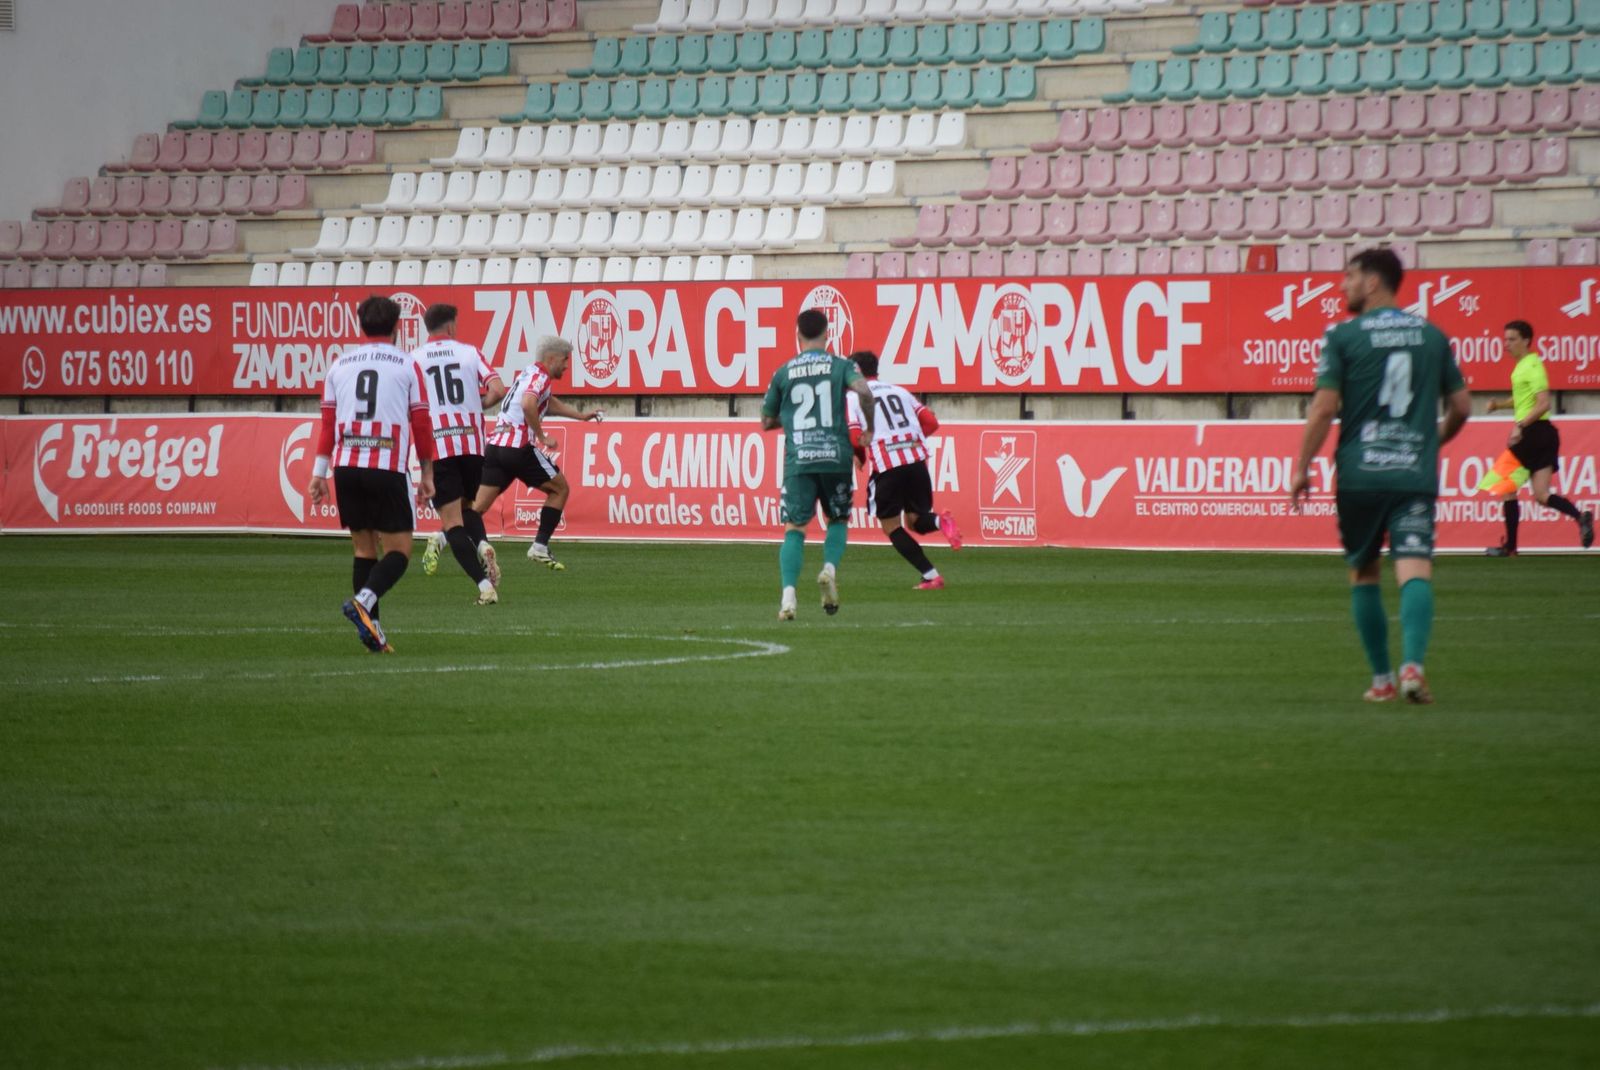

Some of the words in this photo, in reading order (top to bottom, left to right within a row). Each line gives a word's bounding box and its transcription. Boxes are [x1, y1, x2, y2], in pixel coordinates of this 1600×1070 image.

[0, 295, 212, 334] www.cubiex.es
[232, 292, 361, 338] FUNDACIÓN
[1321, 297, 1341, 318] sgc
[1459, 295, 1480, 317] sgc
[474, 288, 697, 388] ZAMORA
[704, 286, 783, 388] CF
[877, 282, 1119, 387] ZAMORA
[1122, 280, 1210, 387] CF
[60, 349, 101, 386] 675
[108, 349, 148, 386] 630
[155, 349, 194, 386] 110
[370, 351, 404, 366] LOSADA
[355, 369, 379, 421] 9
[426, 363, 465, 406] 16
[1378, 351, 1415, 418] 4
[790, 380, 834, 431] 21
[874, 394, 910, 431] 19
[66, 423, 224, 492] Freigel
[581, 431, 632, 489] E.S.
[641, 431, 765, 490] CAMINO
[64, 504, 71, 515] A
[74, 503, 125, 516] GOODLIFE
[128, 503, 162, 515] FOODS
[166, 502, 217, 515] COMPANY
[608, 492, 703, 526] Morales
[710, 493, 748, 527] del
[982, 515, 1035, 537] RepoSTAR
[1136, 502, 1150, 516] EL
[1152, 502, 1199, 516] CENTRO
[1201, 502, 1268, 516] COMERCIAL
[1270, 502, 1287, 516] DE
[1288, 502, 1338, 517] ZMORA
